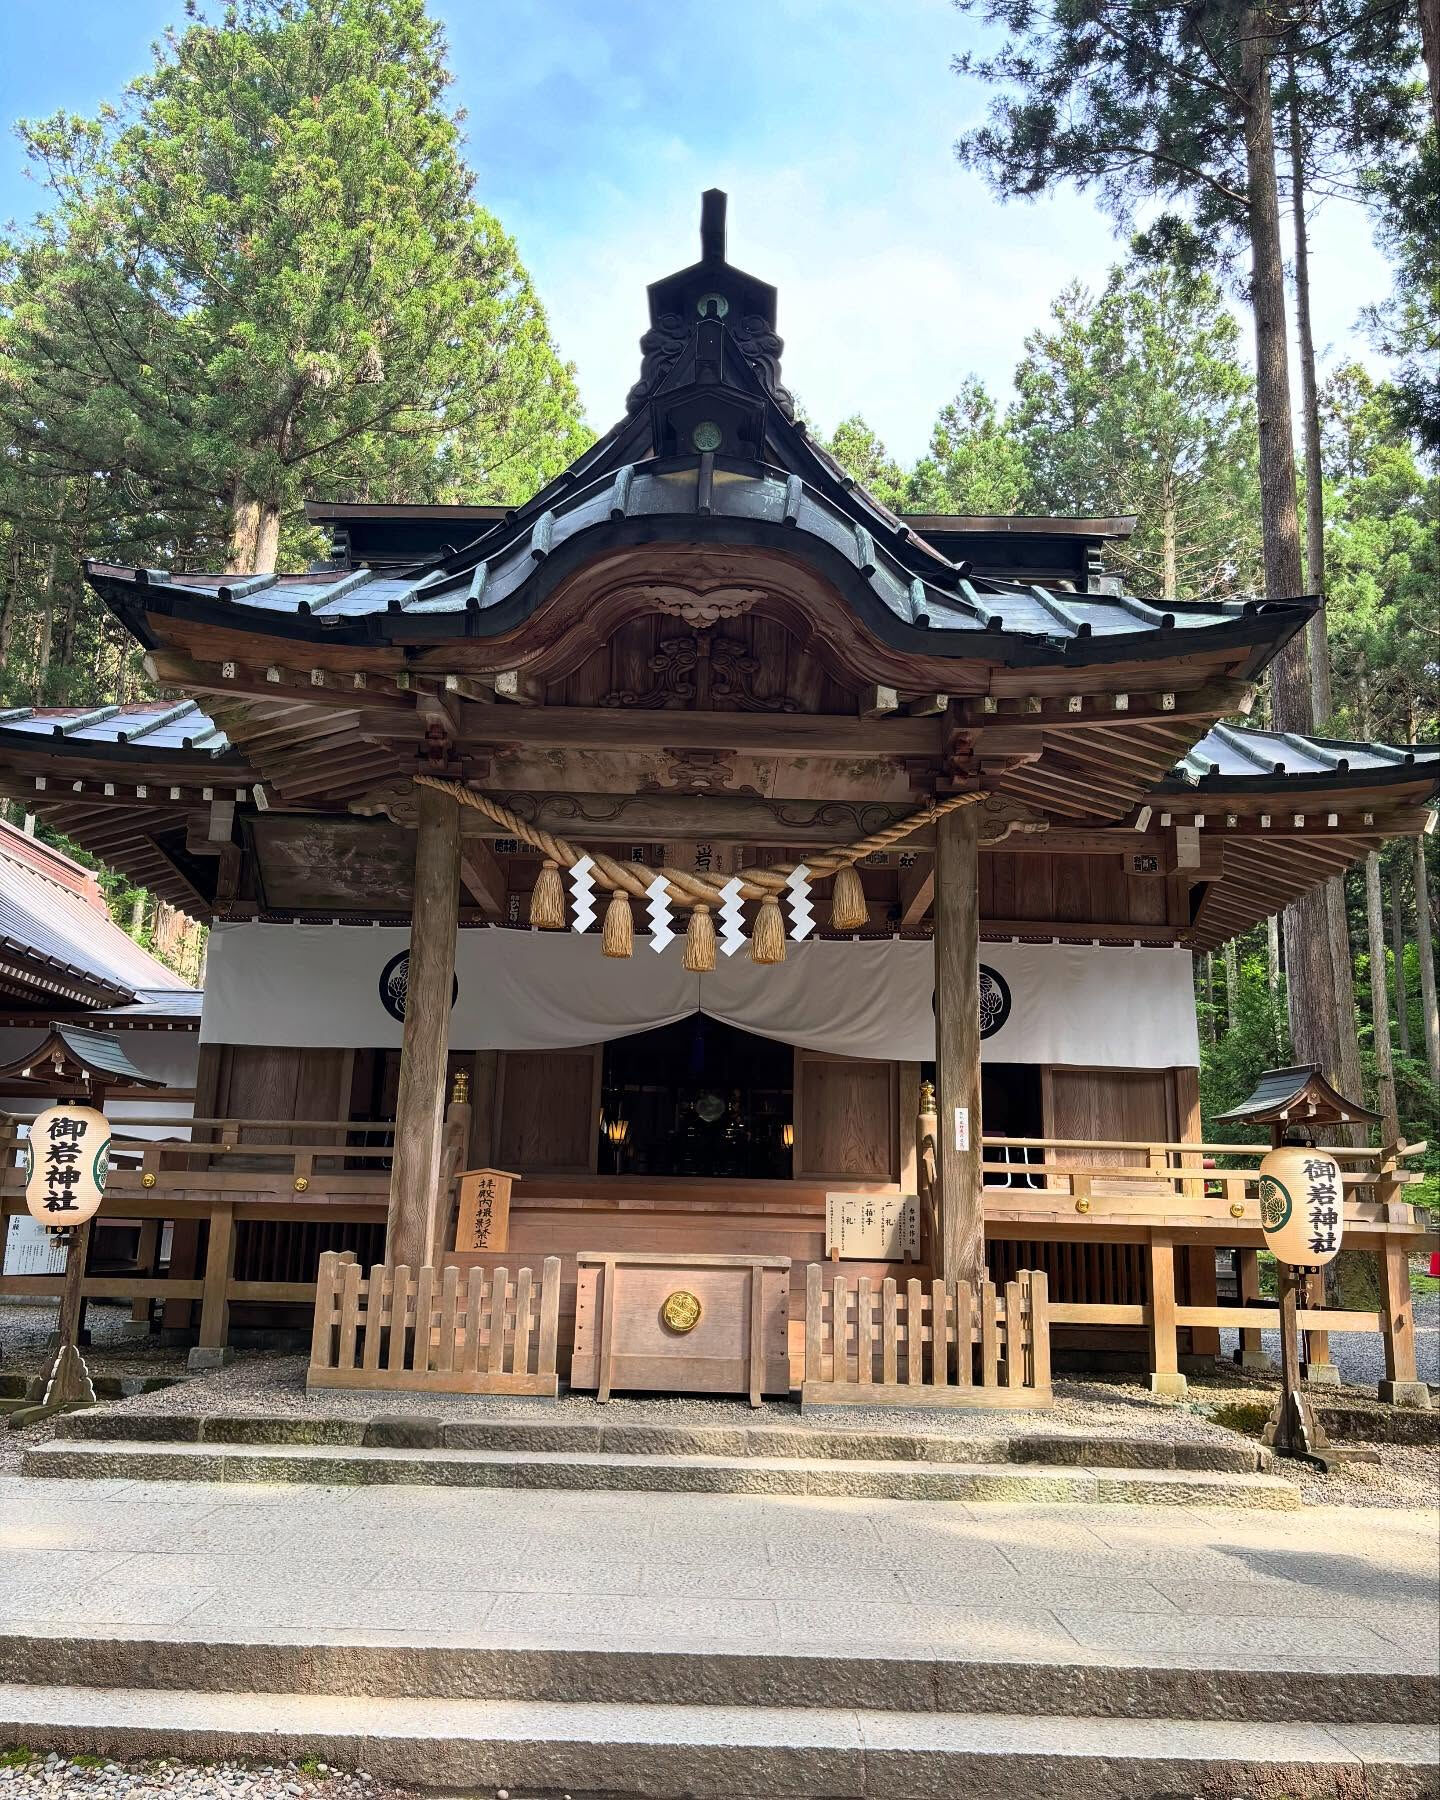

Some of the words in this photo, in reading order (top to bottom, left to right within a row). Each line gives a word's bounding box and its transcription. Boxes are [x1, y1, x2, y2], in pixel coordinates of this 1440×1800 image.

[42, 1117, 88, 1212] 御岩神社
[1302, 1159, 1338, 1254] 御岩神社
[473, 1179, 496, 1249] 拝殿内撮影禁止
